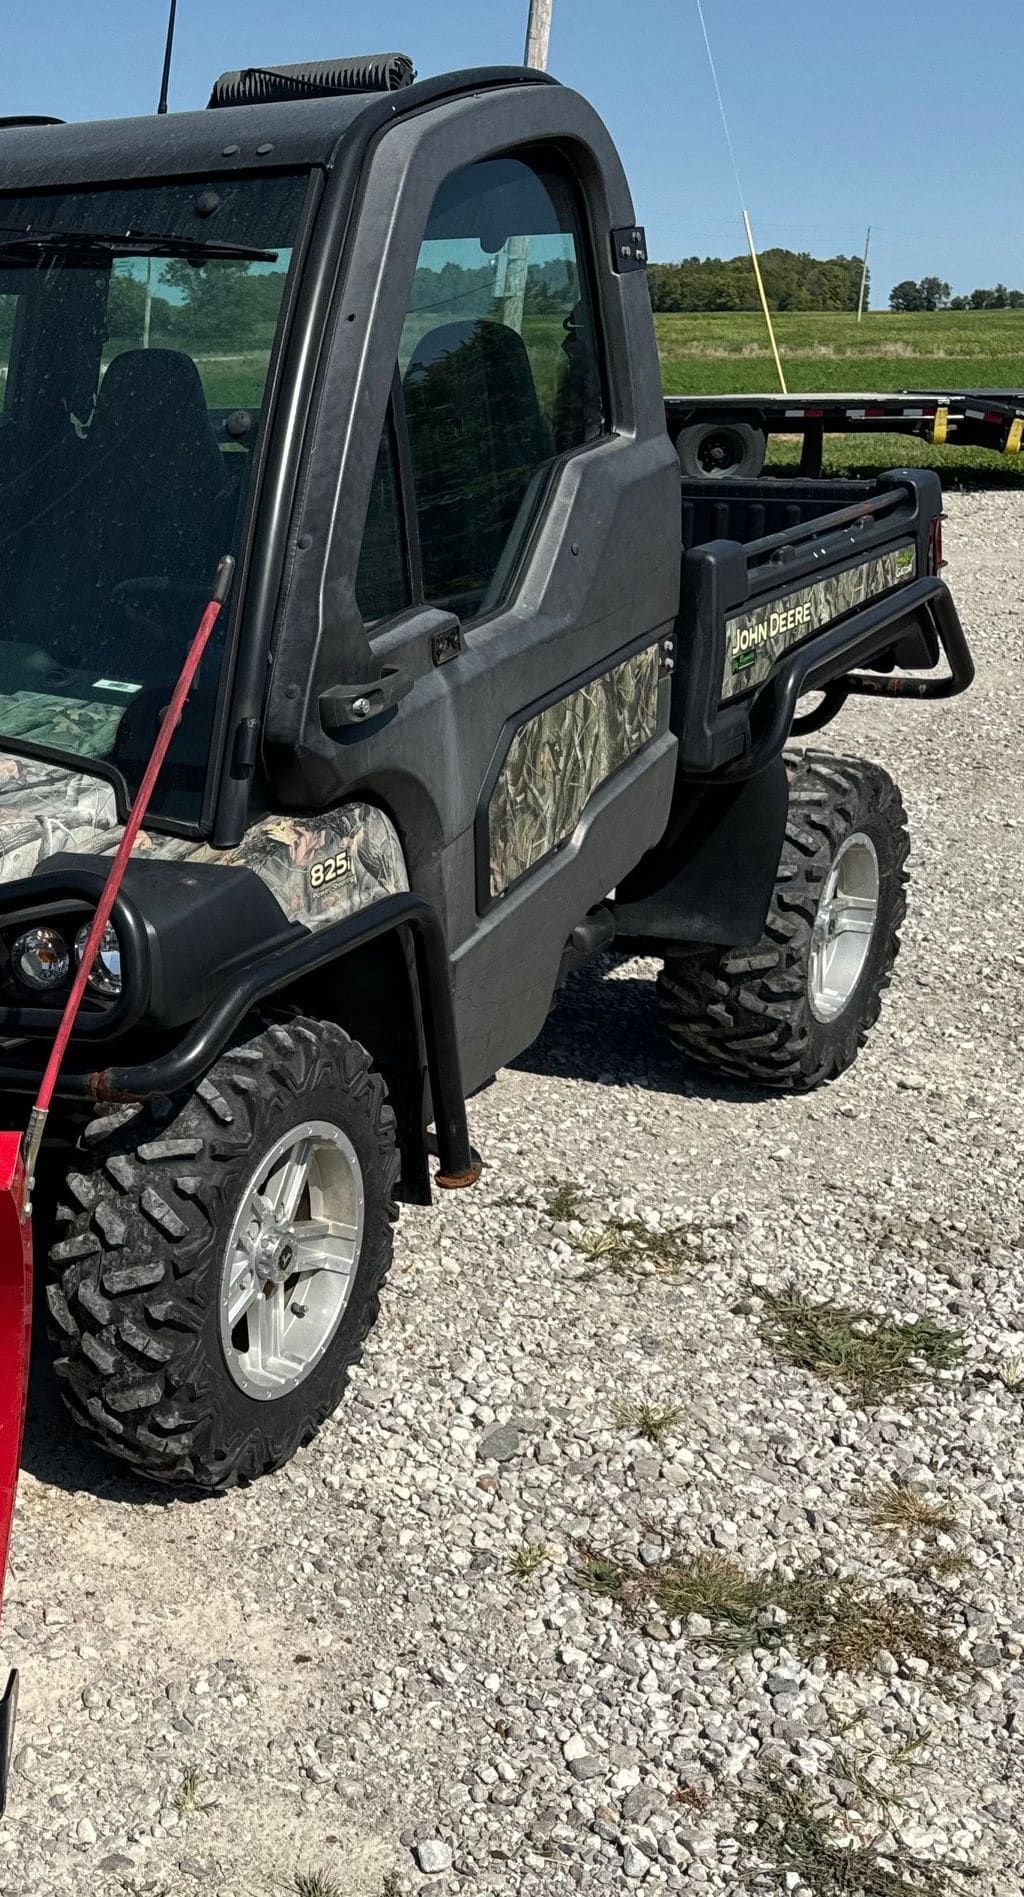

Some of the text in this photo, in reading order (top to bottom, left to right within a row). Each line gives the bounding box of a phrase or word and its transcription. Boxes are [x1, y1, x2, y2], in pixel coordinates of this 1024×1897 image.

[732, 602, 812, 655] JOHN DEERE
[310, 851, 351, 888] 825i
